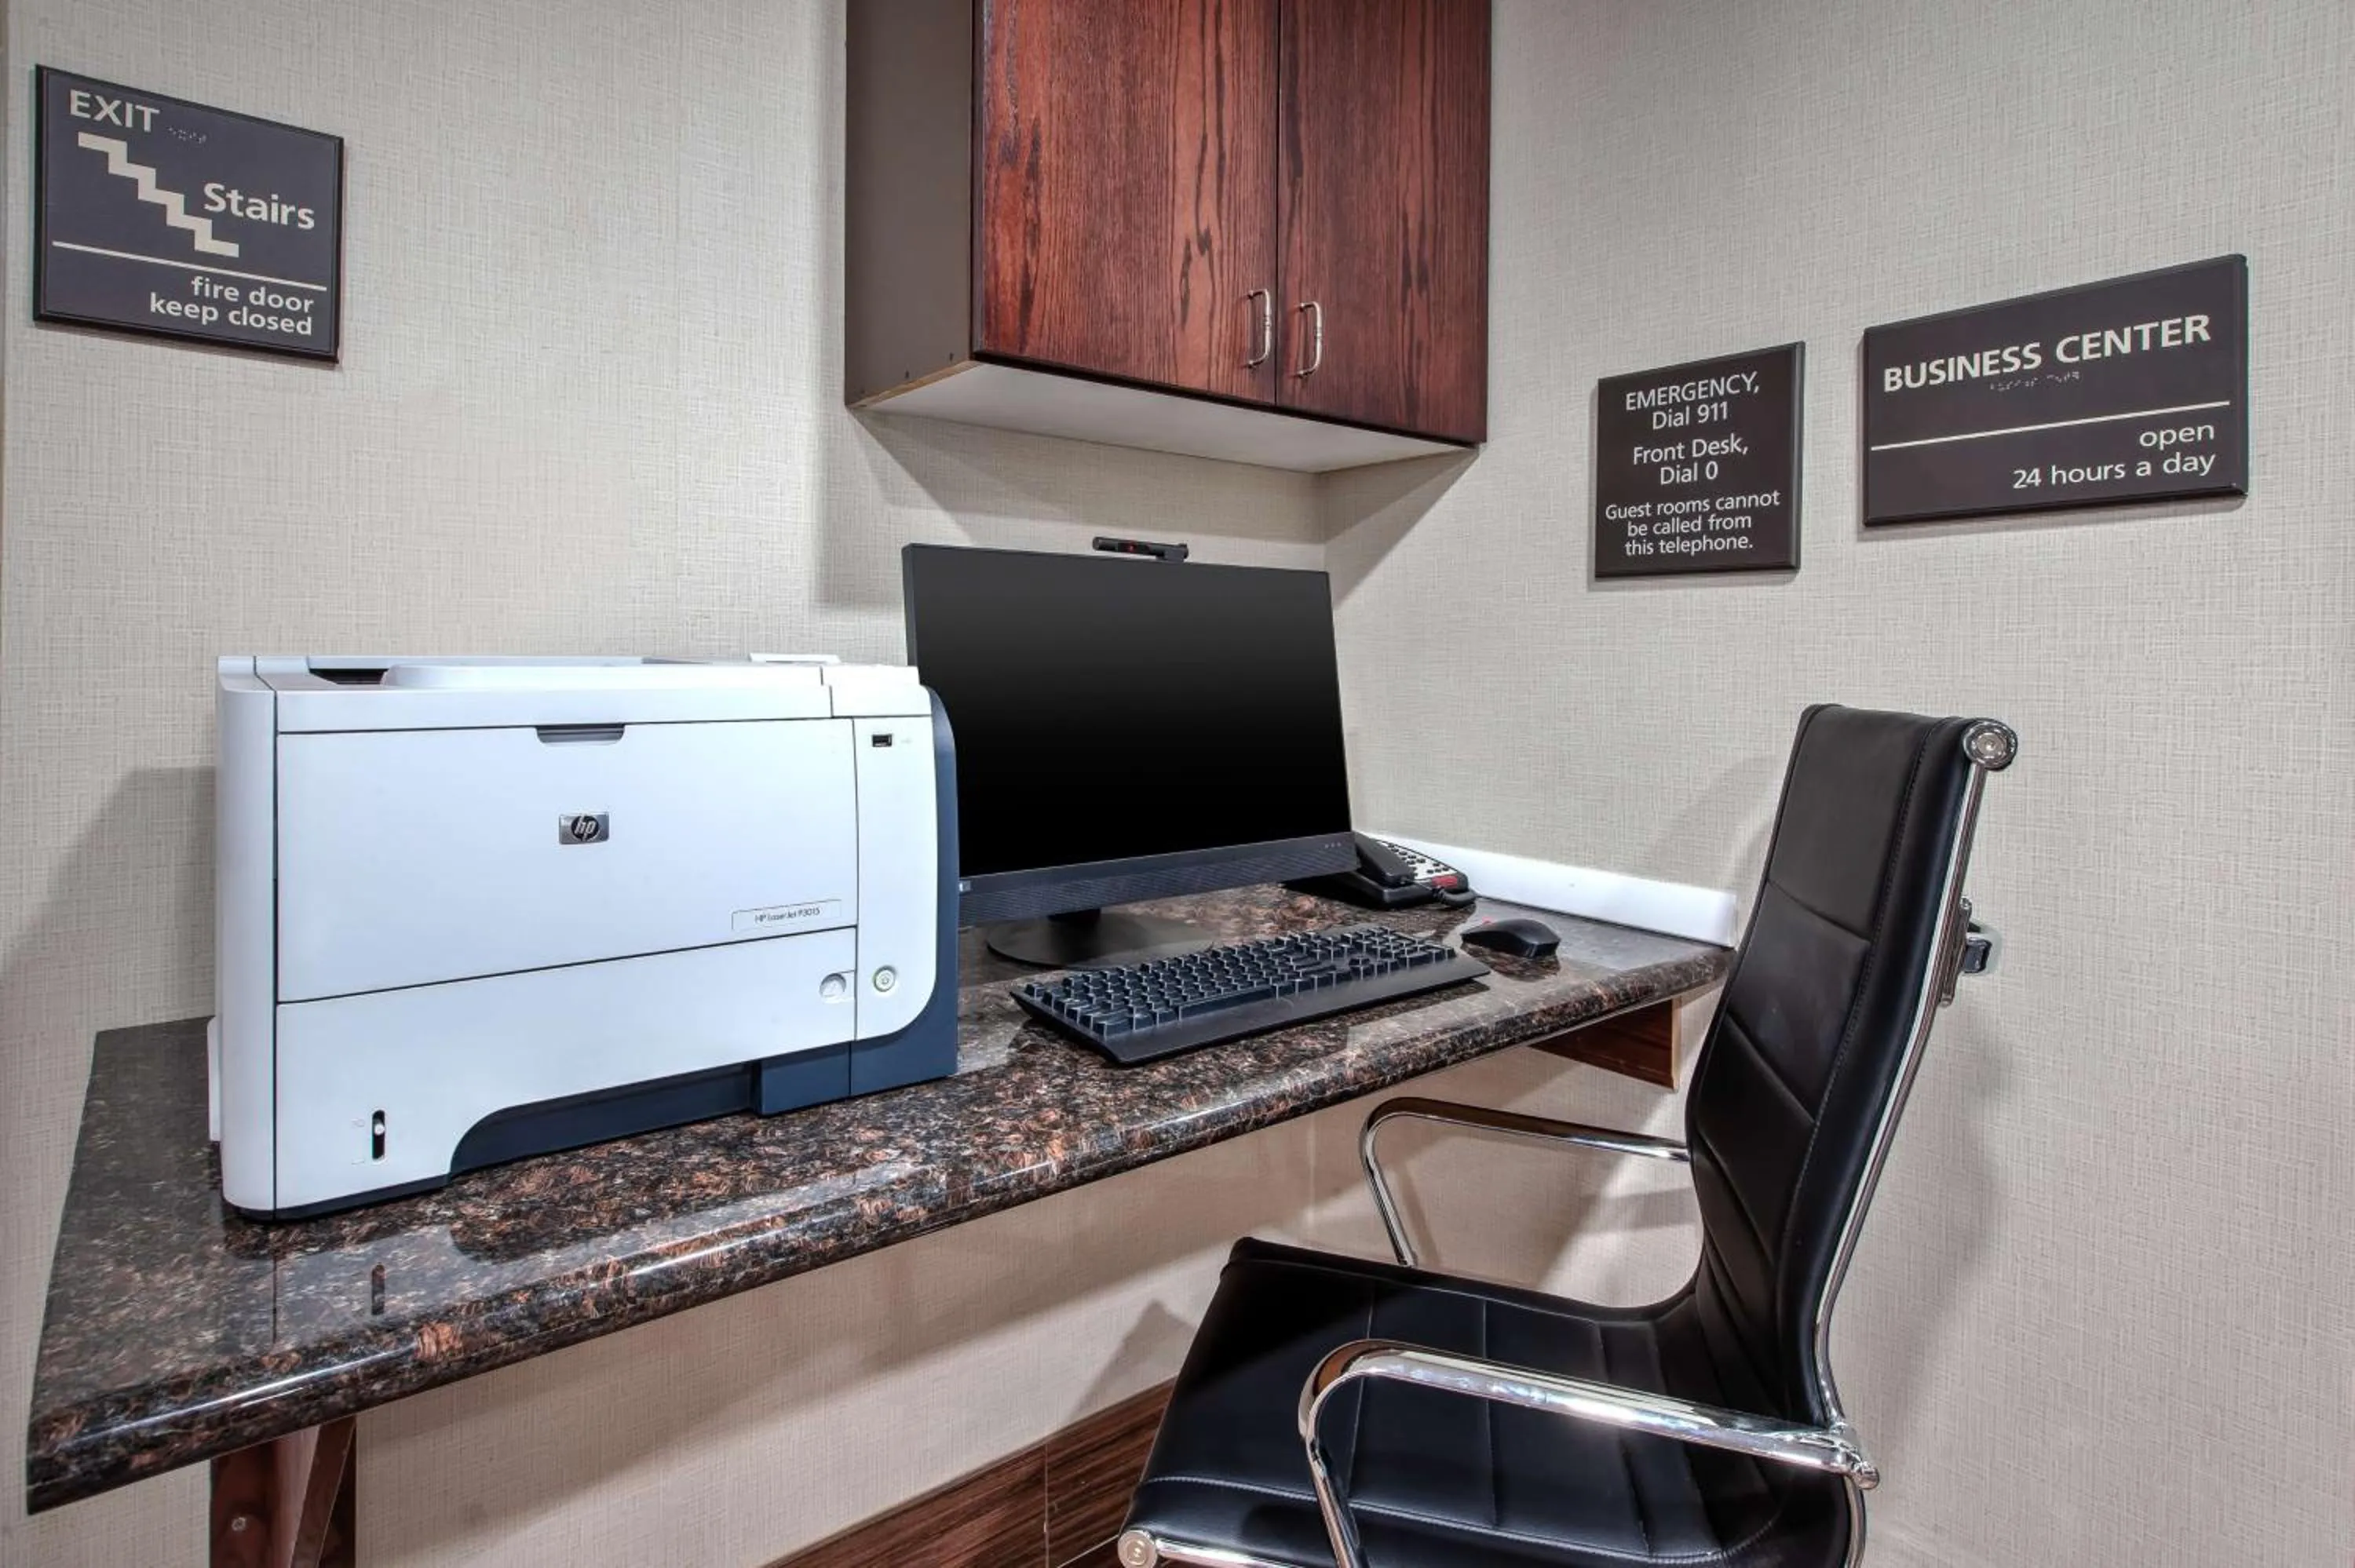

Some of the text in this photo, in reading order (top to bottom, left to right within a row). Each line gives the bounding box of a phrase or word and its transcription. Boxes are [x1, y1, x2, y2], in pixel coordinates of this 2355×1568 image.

[69, 89, 160, 132] EXIT
[203, 182, 315, 230] Stairs
[191, 275, 315, 313] fire door
[149, 291, 312, 336] keep closed
[1884, 314, 2211, 392] BUSINESS CENTER
[1625, 370, 1760, 410] EMERGENCY,
[1652, 401, 1728, 430] Dial 911
[1632, 432, 1749, 465] Front Desk,
[2139, 425, 2215, 451] open
[1659, 460, 1718, 486] Dial 0
[2012, 451, 2216, 490] 24 hours a day
[1605, 490, 1781, 520] Guest rooms cannot
[1627, 513, 1752, 538] be called from
[1624, 534, 1754, 556] this telephone.
[574, 814, 596, 841] hp
[754, 913, 766, 923] HP
